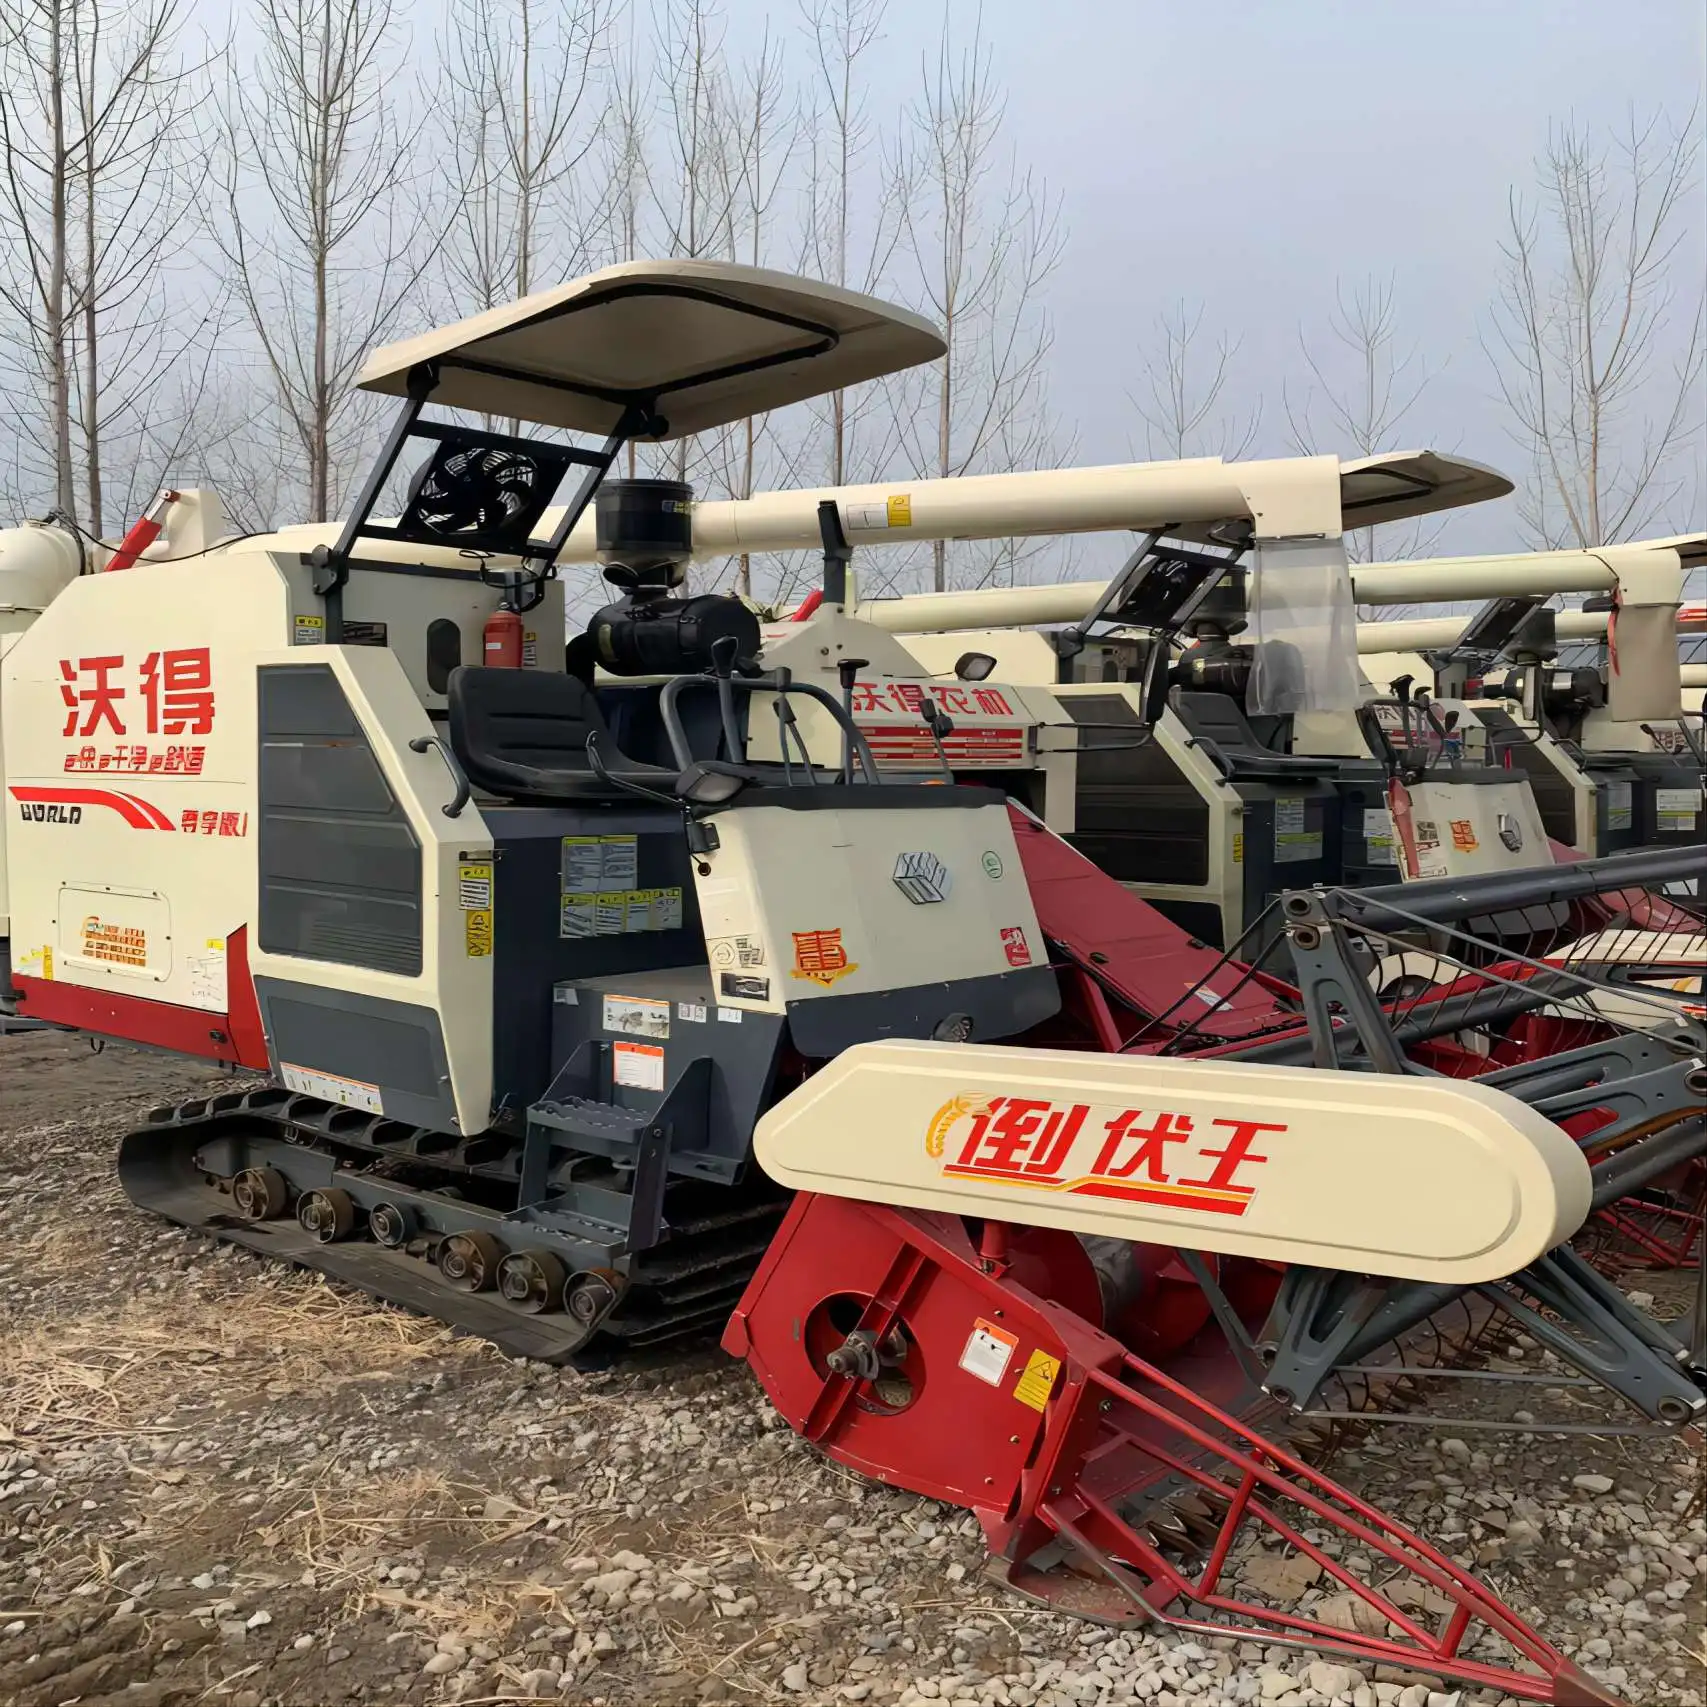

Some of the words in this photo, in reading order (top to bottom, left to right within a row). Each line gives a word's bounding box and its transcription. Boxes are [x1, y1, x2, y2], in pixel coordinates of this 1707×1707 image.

[59, 647, 215, 737] 沃得
[958, 1096, 1288, 1194] 倒伏王
